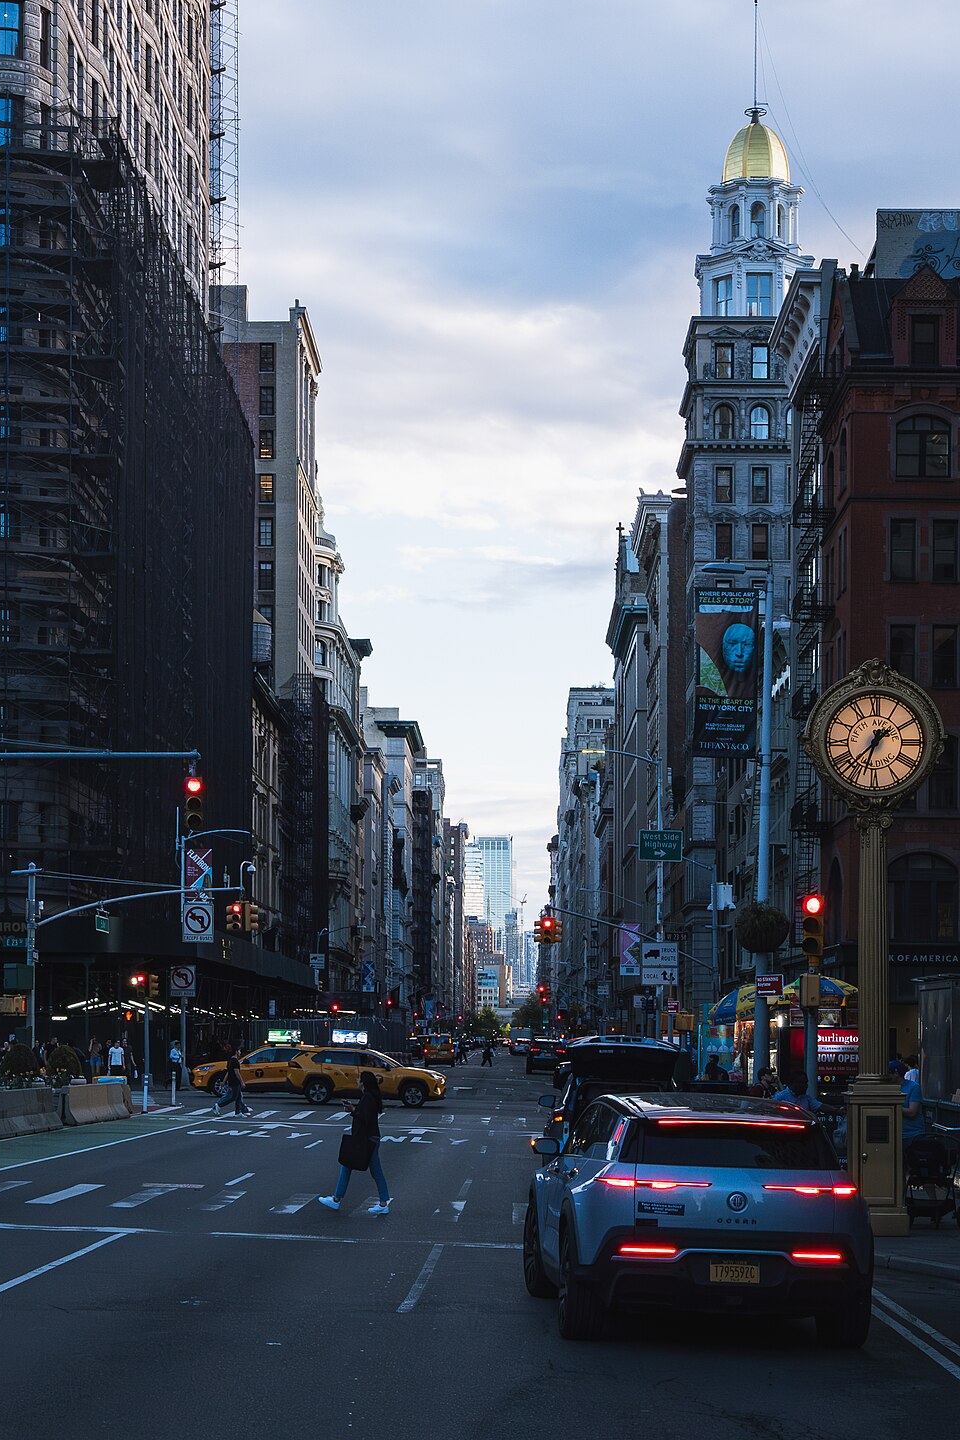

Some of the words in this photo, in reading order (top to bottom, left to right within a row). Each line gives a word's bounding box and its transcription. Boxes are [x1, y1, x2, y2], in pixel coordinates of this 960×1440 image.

[851, 721, 869, 743] FIFTH
[872, 719, 900, 742] AVENUE
[645, 841, 677, 849] Highway
[186, 849, 210, 872] FLATIRON
[897, 954, 910, 962] OF
[913, 954, 958, 962] AMERICA
[380, 1135, 470, 1146] NLY
[715, 1265, 755, 1279] T795592C
